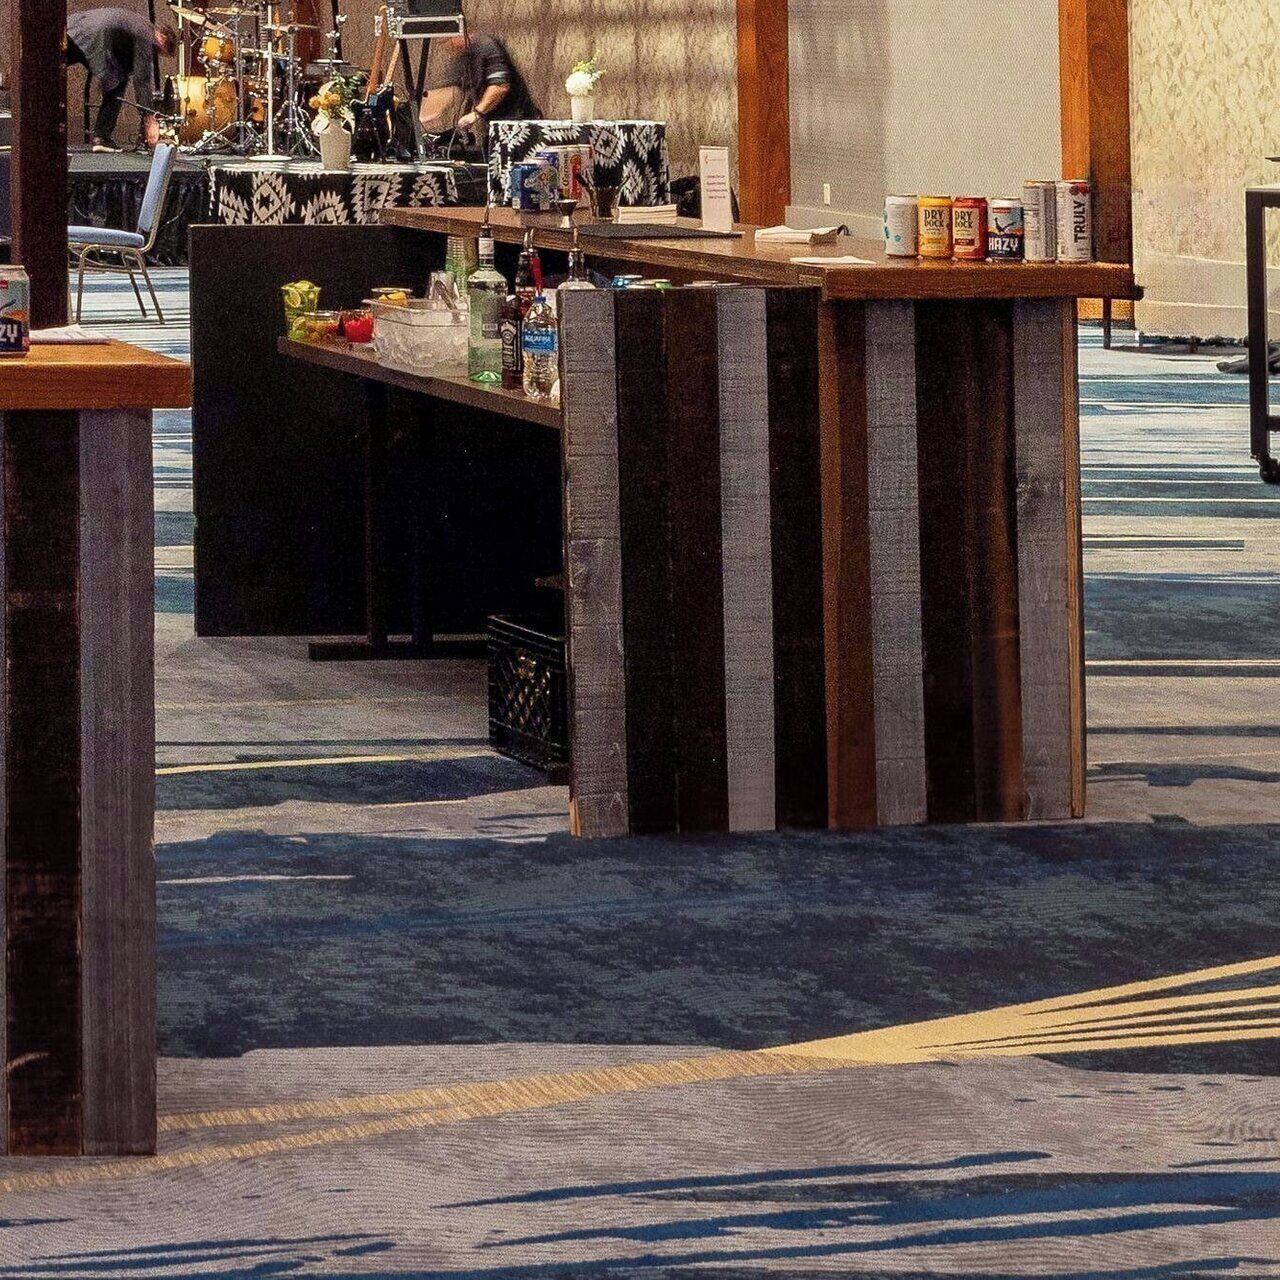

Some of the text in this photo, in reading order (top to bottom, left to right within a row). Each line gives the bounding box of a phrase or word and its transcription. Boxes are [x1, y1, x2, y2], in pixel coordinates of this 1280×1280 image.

[924, 209, 944, 220] DRY
[954, 210, 973, 221] DRY
[924, 219, 945, 228] DOCK
[1073, 200, 1086, 244] TRULY
[988, 237, 1019, 252] HAZY
